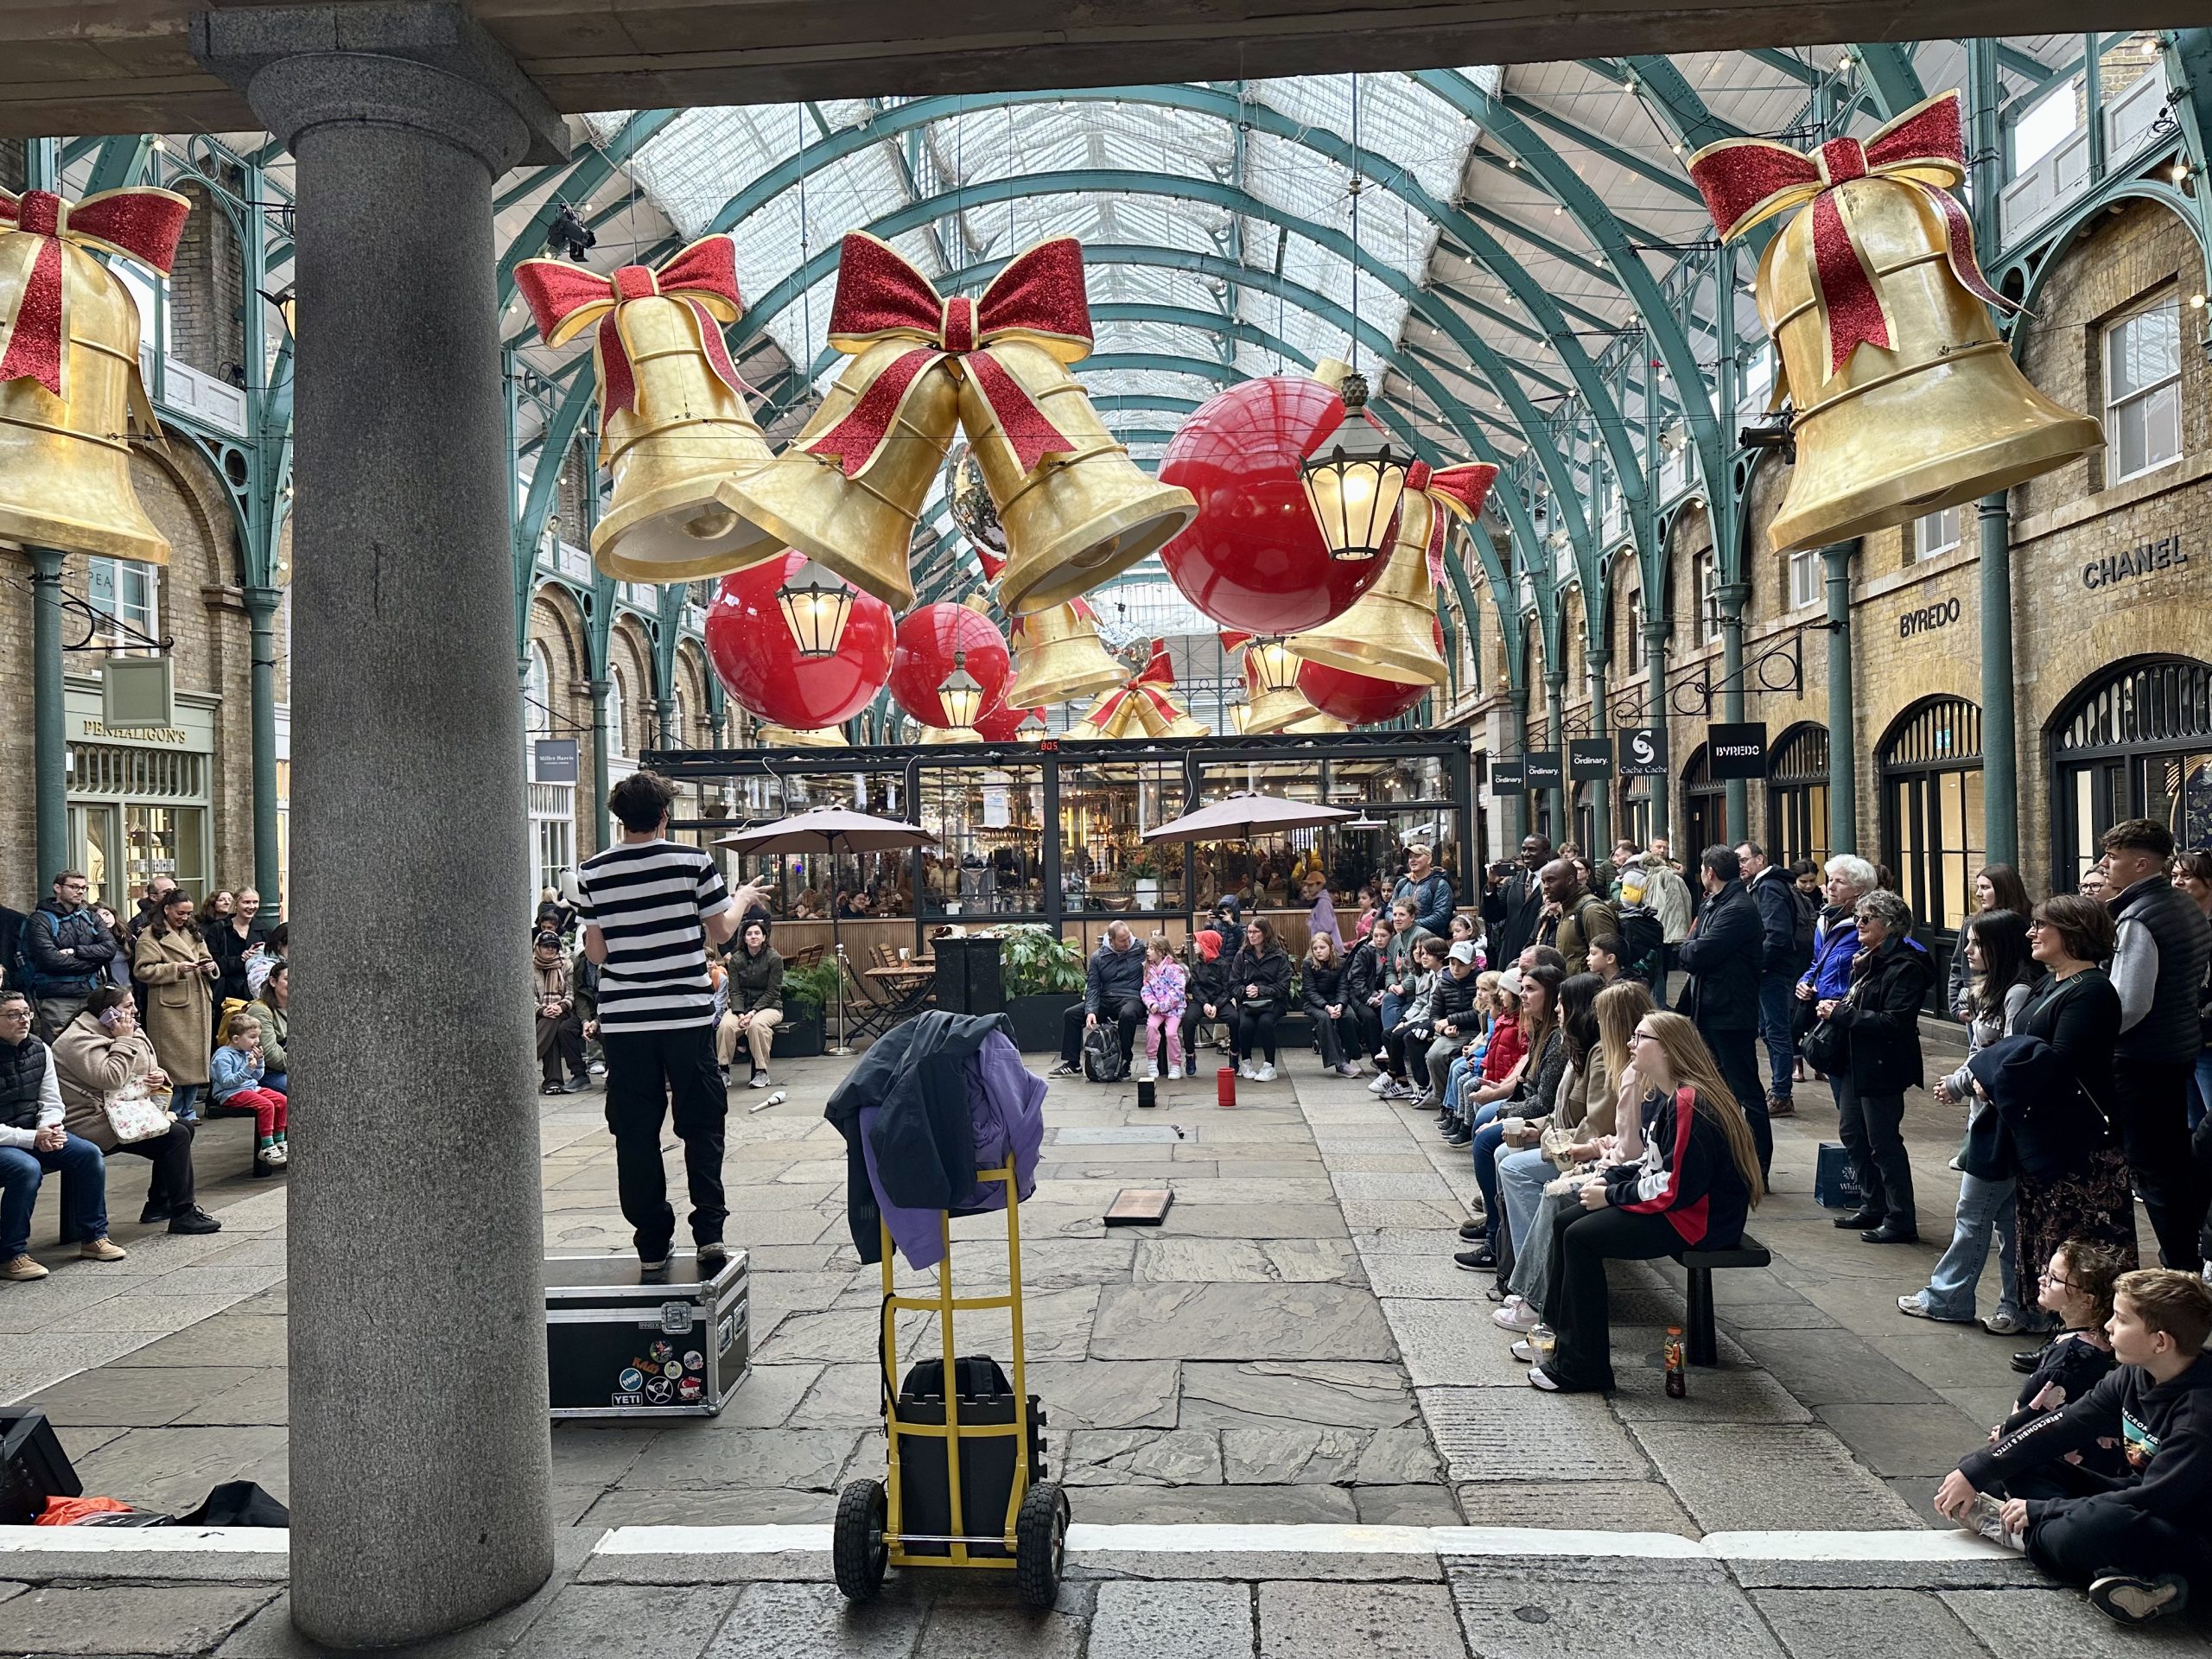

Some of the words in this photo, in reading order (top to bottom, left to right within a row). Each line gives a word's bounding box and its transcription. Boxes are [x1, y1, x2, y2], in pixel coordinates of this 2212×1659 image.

[2083, 535, 2188, 589] CHANEL
[1900, 597, 1961, 639] BYREDO
[1573, 757, 1609, 766] Ordinary.
[1716, 745, 1760, 757] BYREDO
[614, 1395, 640, 1404] YETI
[2017, 1411, 2063, 1441] ABERCROMBIE
